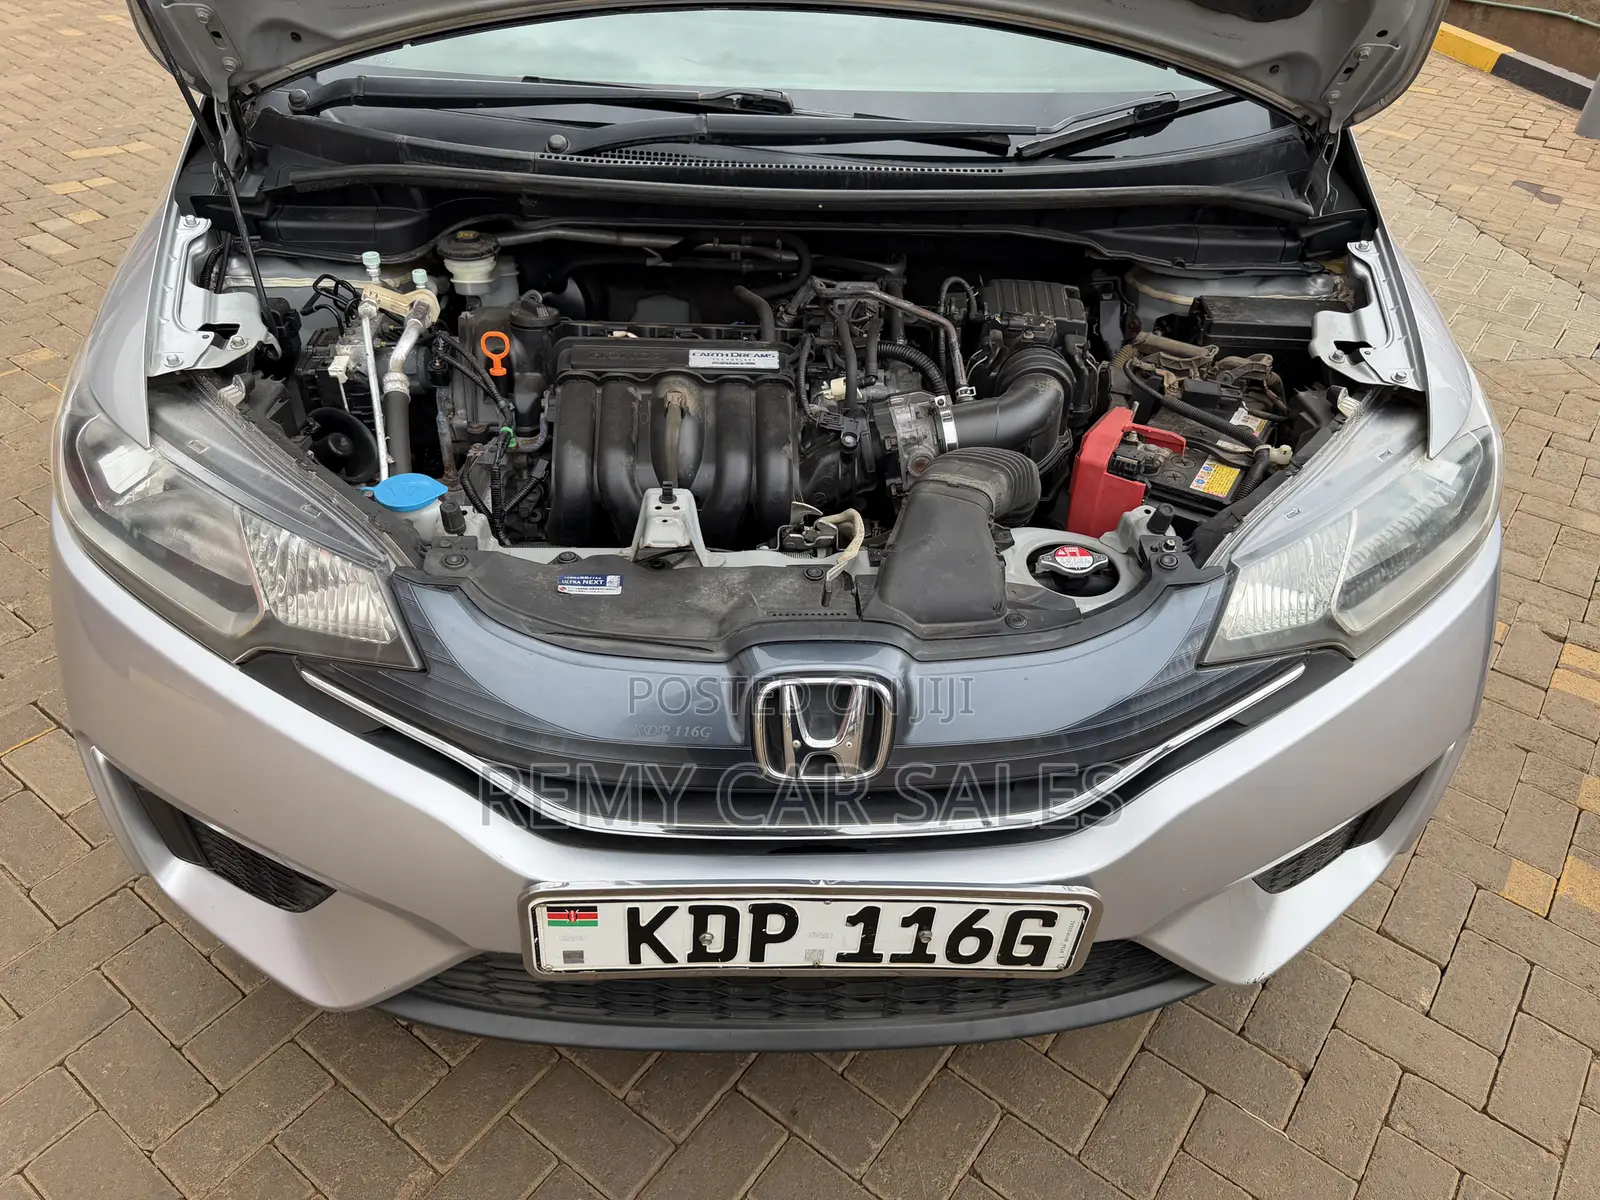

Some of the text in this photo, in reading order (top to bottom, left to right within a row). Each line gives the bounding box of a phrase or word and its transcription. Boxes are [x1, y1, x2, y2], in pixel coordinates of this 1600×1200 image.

[630, 724, 713, 742] KDP 116G
[626, 902, 800, 965] KDP
[835, 905, 1059, 967] 116G
